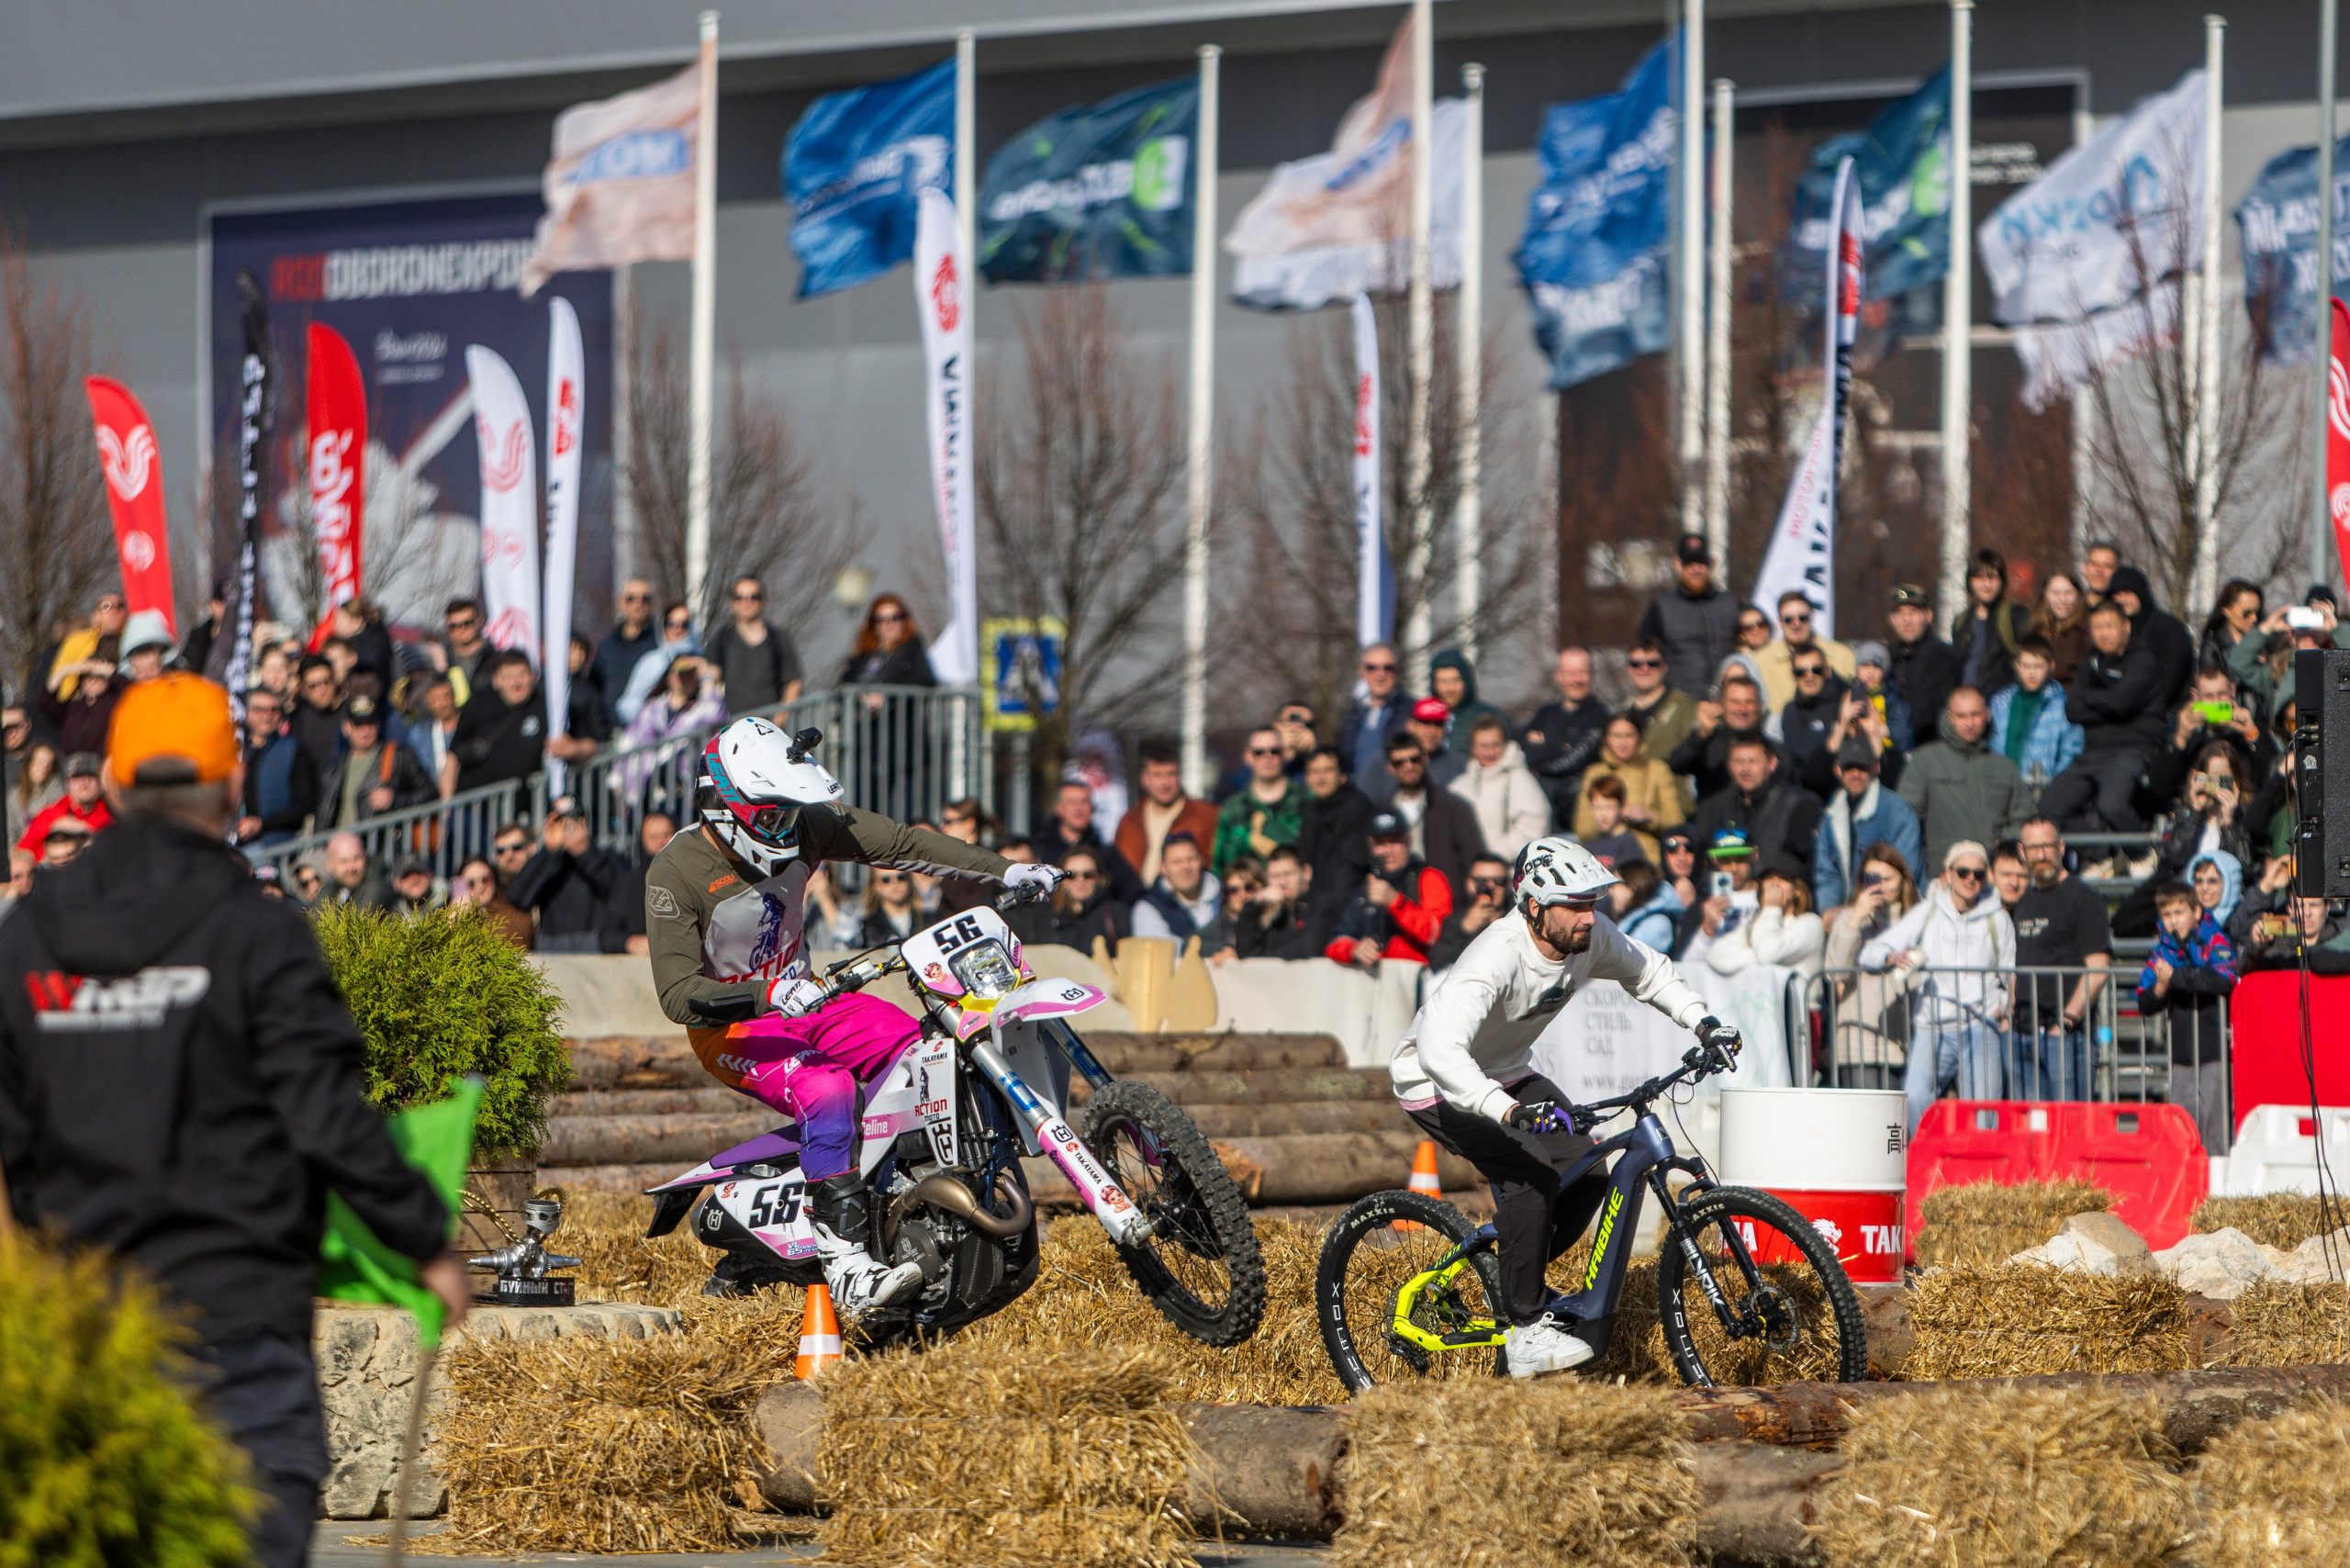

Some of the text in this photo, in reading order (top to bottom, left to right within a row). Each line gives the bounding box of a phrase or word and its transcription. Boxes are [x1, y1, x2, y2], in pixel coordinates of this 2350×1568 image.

[706, 753, 744, 805] LEATT
[827, 782, 843, 794] LEATT
[932, 913, 984, 956] 56
[781, 980, 801, 1005] LEATT
[922, 1051, 948, 1064] TAKAYAMA
[914, 1099, 947, 1117] ACTION
[923, 1113, 940, 1122] MOTO
[1074, 1150, 1102, 1185] TAKAYAMA
[748, 1180, 805, 1228] 56
[1692, 1203, 1726, 1224] AXXIS
[1349, 1207, 1396, 1229] MAXXIS
[788, 1241, 800, 1249] VL
[1585, 1186, 1624, 1290] HAIBIKE
[1689, 1252, 1725, 1310] LYRIK
